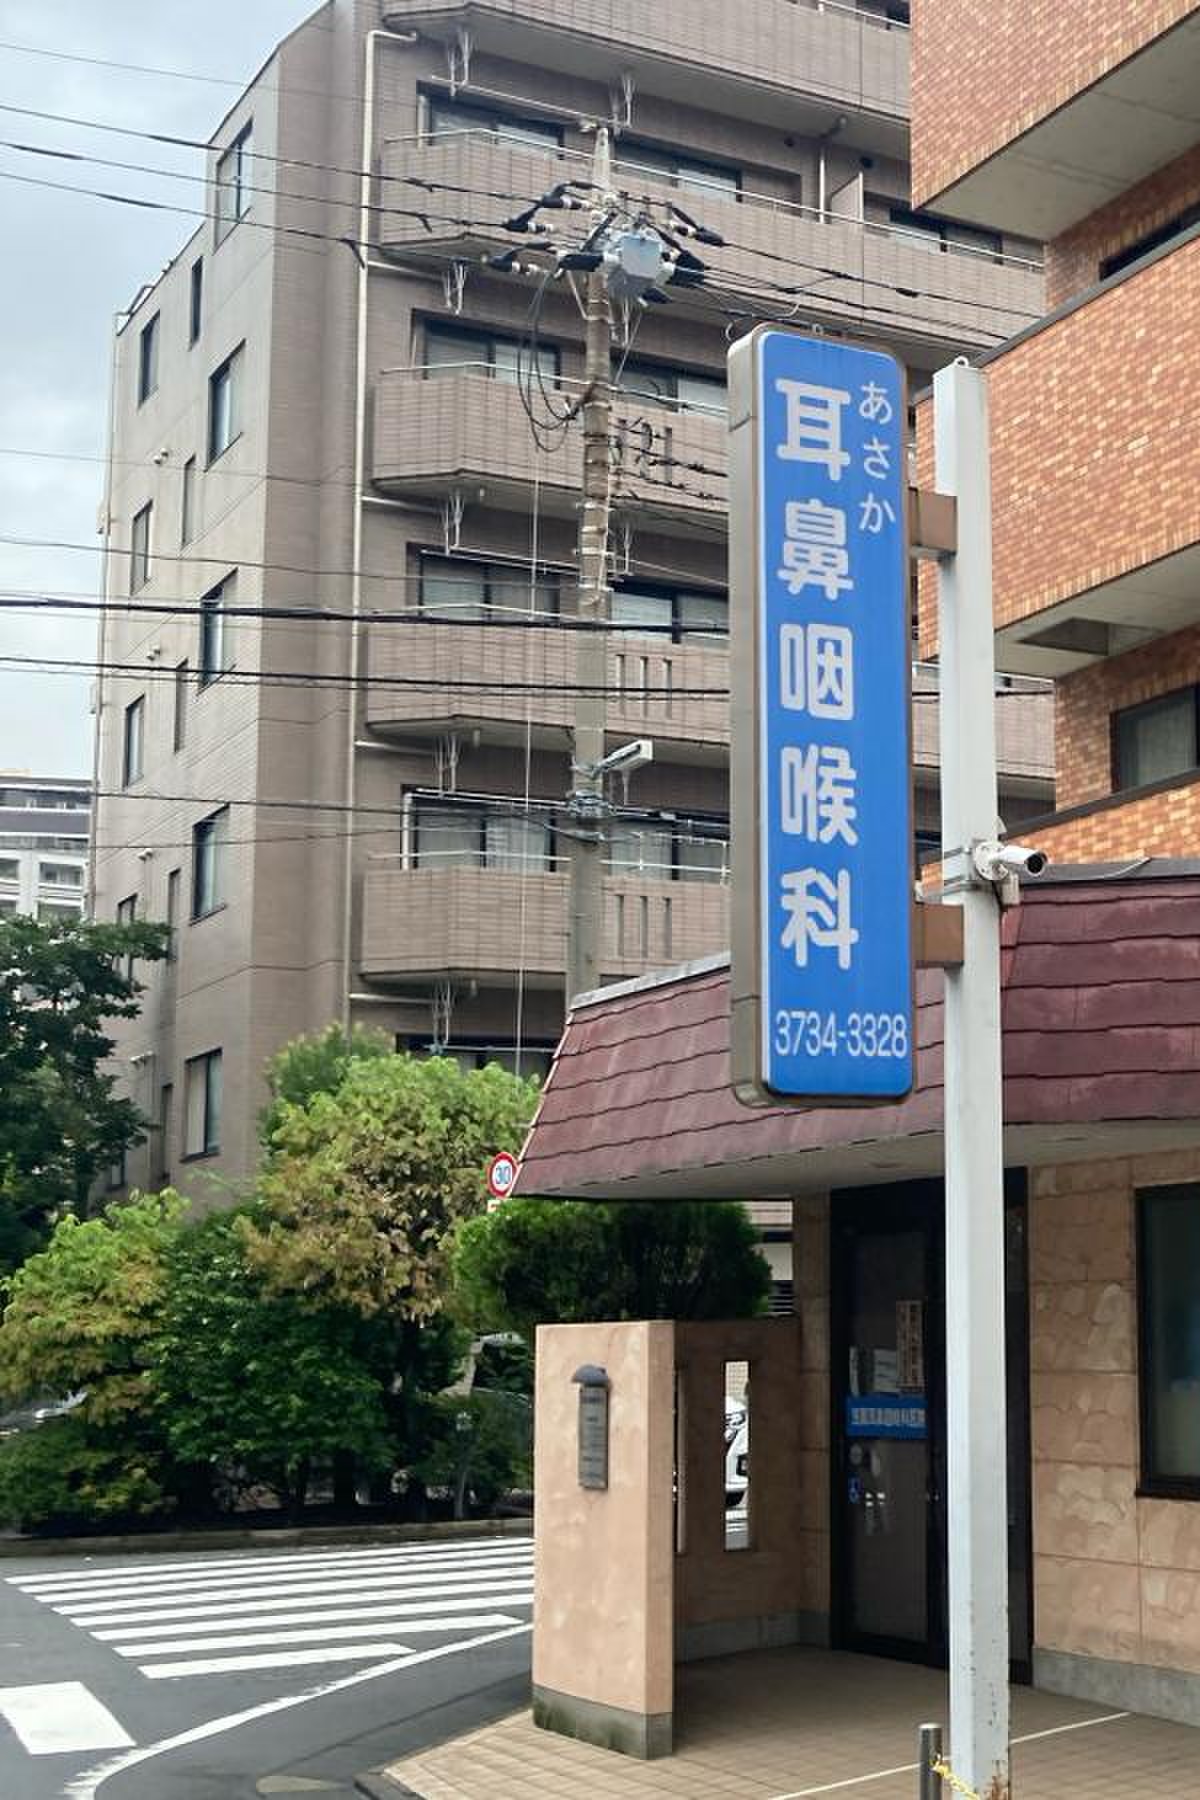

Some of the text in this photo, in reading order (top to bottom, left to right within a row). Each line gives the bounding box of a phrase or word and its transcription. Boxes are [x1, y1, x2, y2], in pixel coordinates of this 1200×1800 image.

[858, 381, 896, 533] あさか
[775, 378, 860, 971] 耳鼻咽喉科
[774, 1009, 908, 1059] 3734-3328
[495, 1165, 512, 1185] 30
